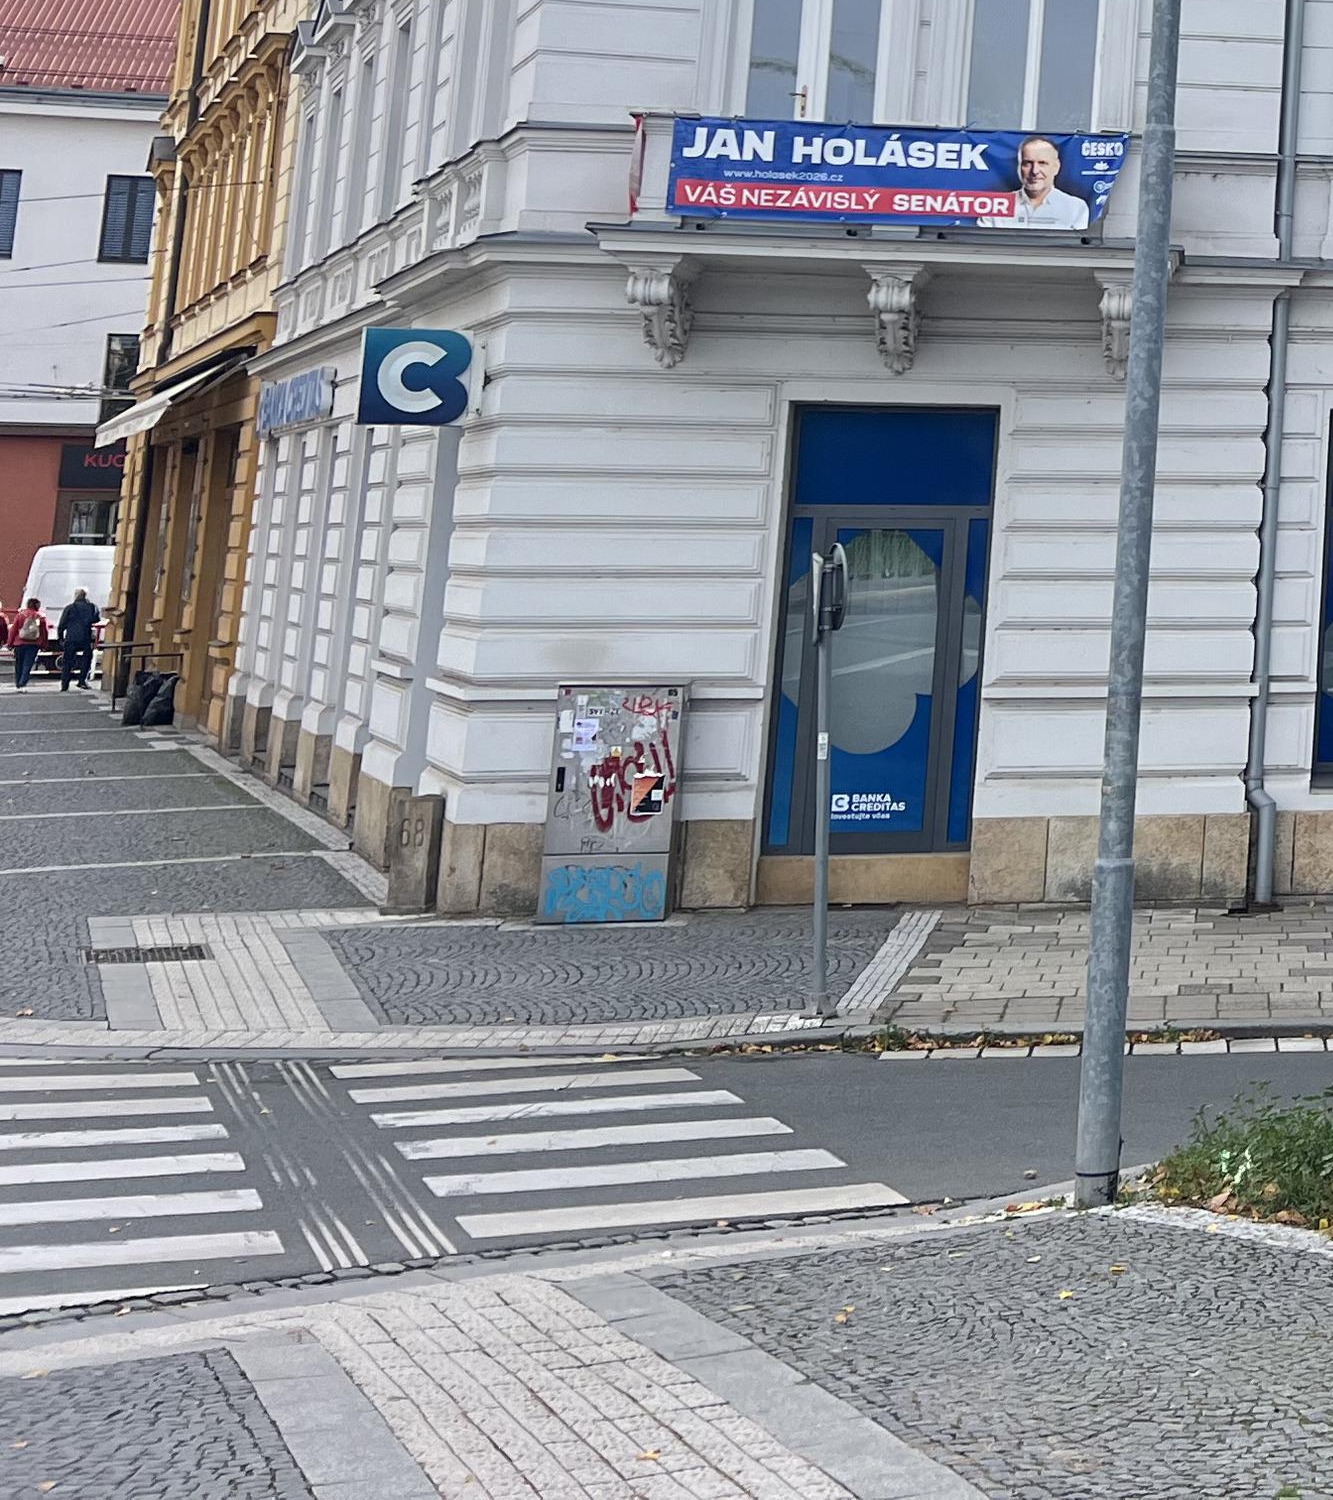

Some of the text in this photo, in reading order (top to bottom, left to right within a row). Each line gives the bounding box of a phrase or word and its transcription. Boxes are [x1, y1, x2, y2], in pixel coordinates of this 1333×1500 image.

[682, 126, 989, 171] JAN HOLÁSEK
[684, 182, 1009, 214] VÁŠ NEZÁVISLÝ SENÁTOR
[851, 802, 906, 811] CREDITAS
[852, 794, 891, 802] BANKA
[401, 818, 424, 847] 68
